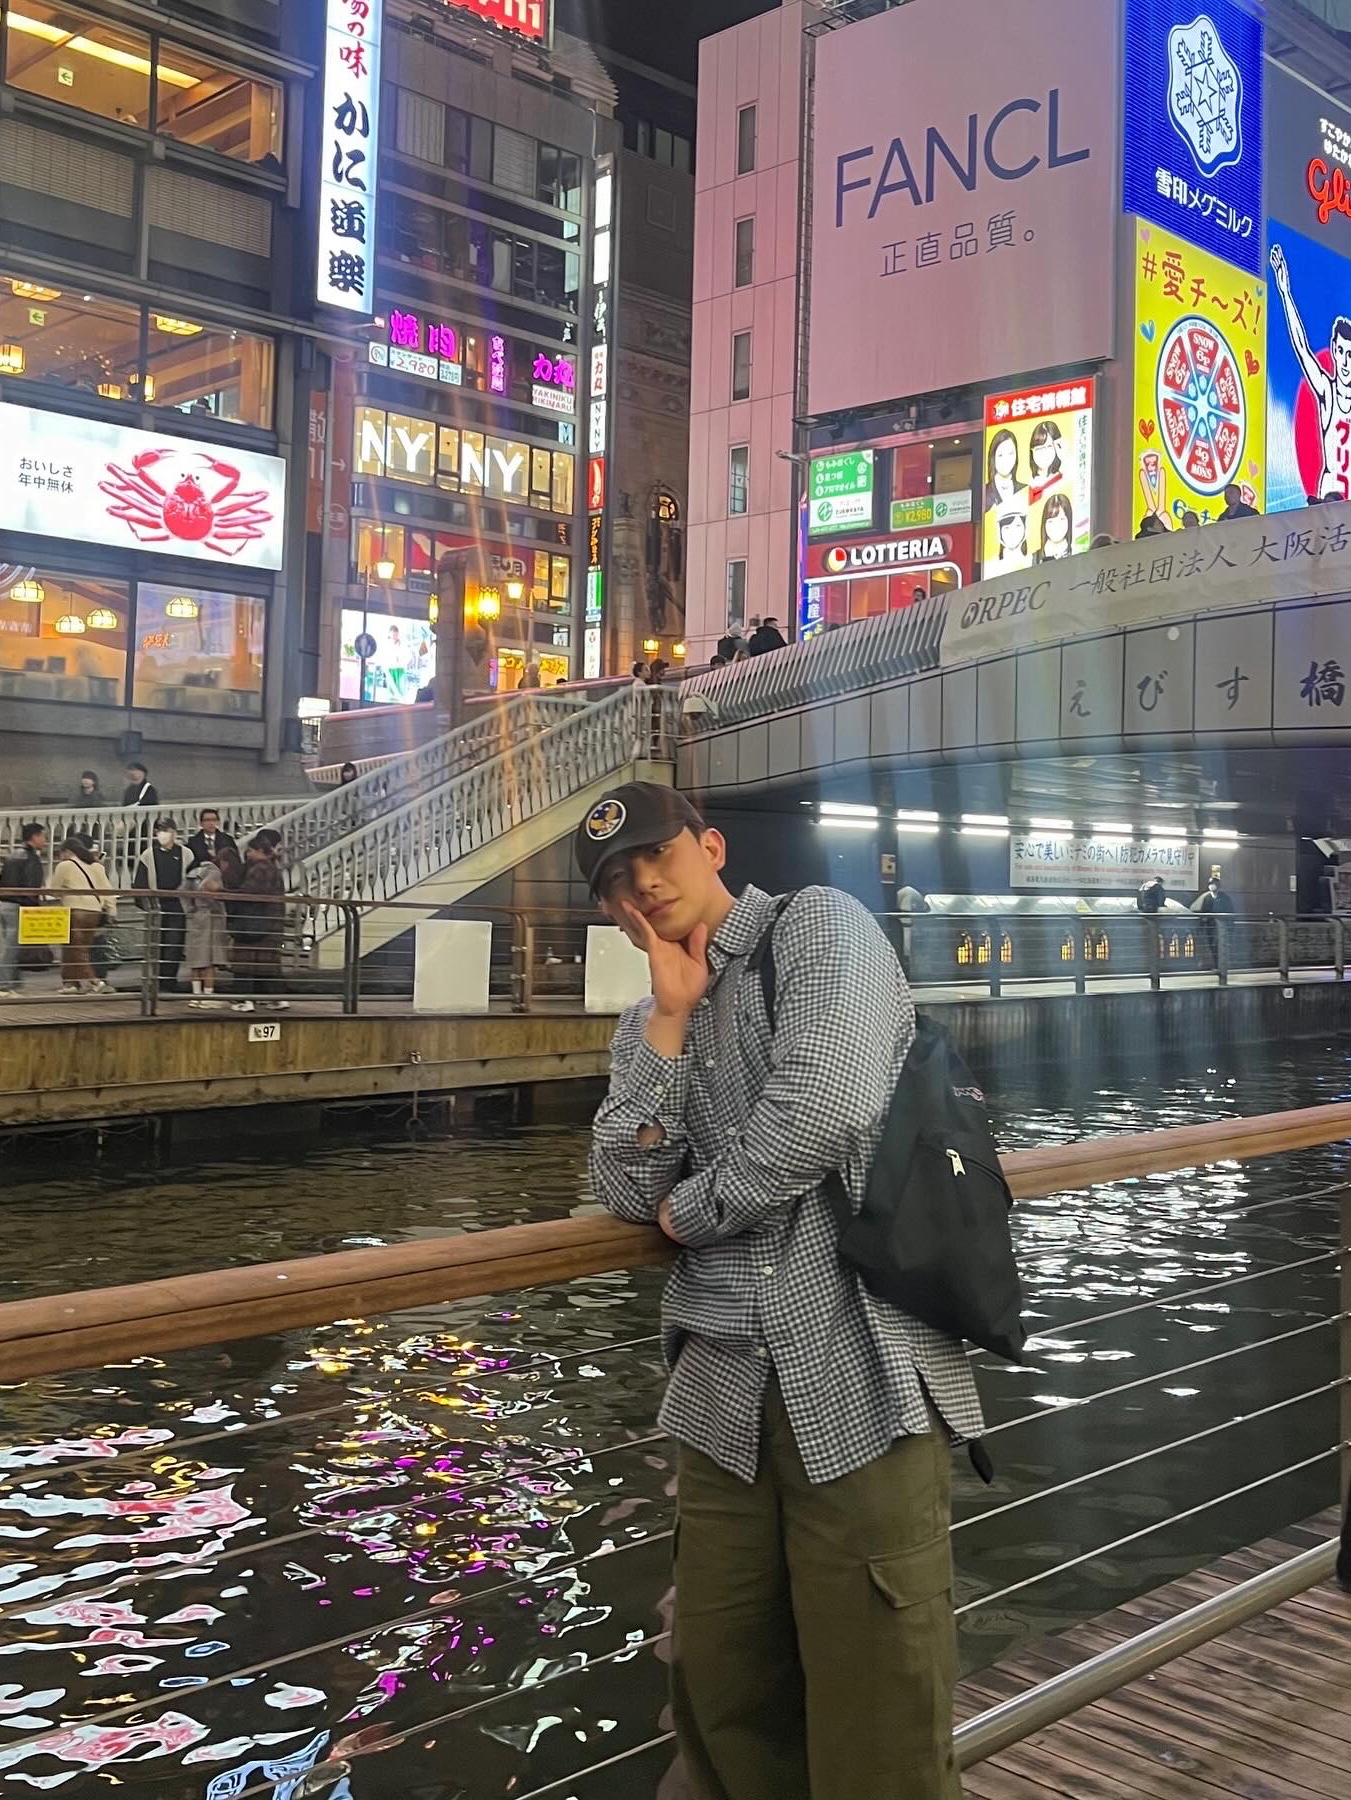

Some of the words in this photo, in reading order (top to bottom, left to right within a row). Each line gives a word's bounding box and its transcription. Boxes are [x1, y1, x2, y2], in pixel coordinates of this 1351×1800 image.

[836, 88, 1090, 228] FANCL
[1155, 166, 1252, 238] 雪印メグミルク
[880, 210, 1034, 277] 正直品質。
[390, 309, 455, 360] 焼肉
[533, 353, 574, 389] 力丸
[18, 472, 74, 494] 年中無休
[19, 456, 73, 479] おいしさ
[361, 419, 430, 473] NY
[461, 442, 524, 493] NY
[850, 536, 944, 566] LOTTERIA
[1068, 545, 1237, 595] 一般社団法人
[1248, 523, 1351, 567] 大阪活
[1069, 659, 1346, 718] えびす橋
